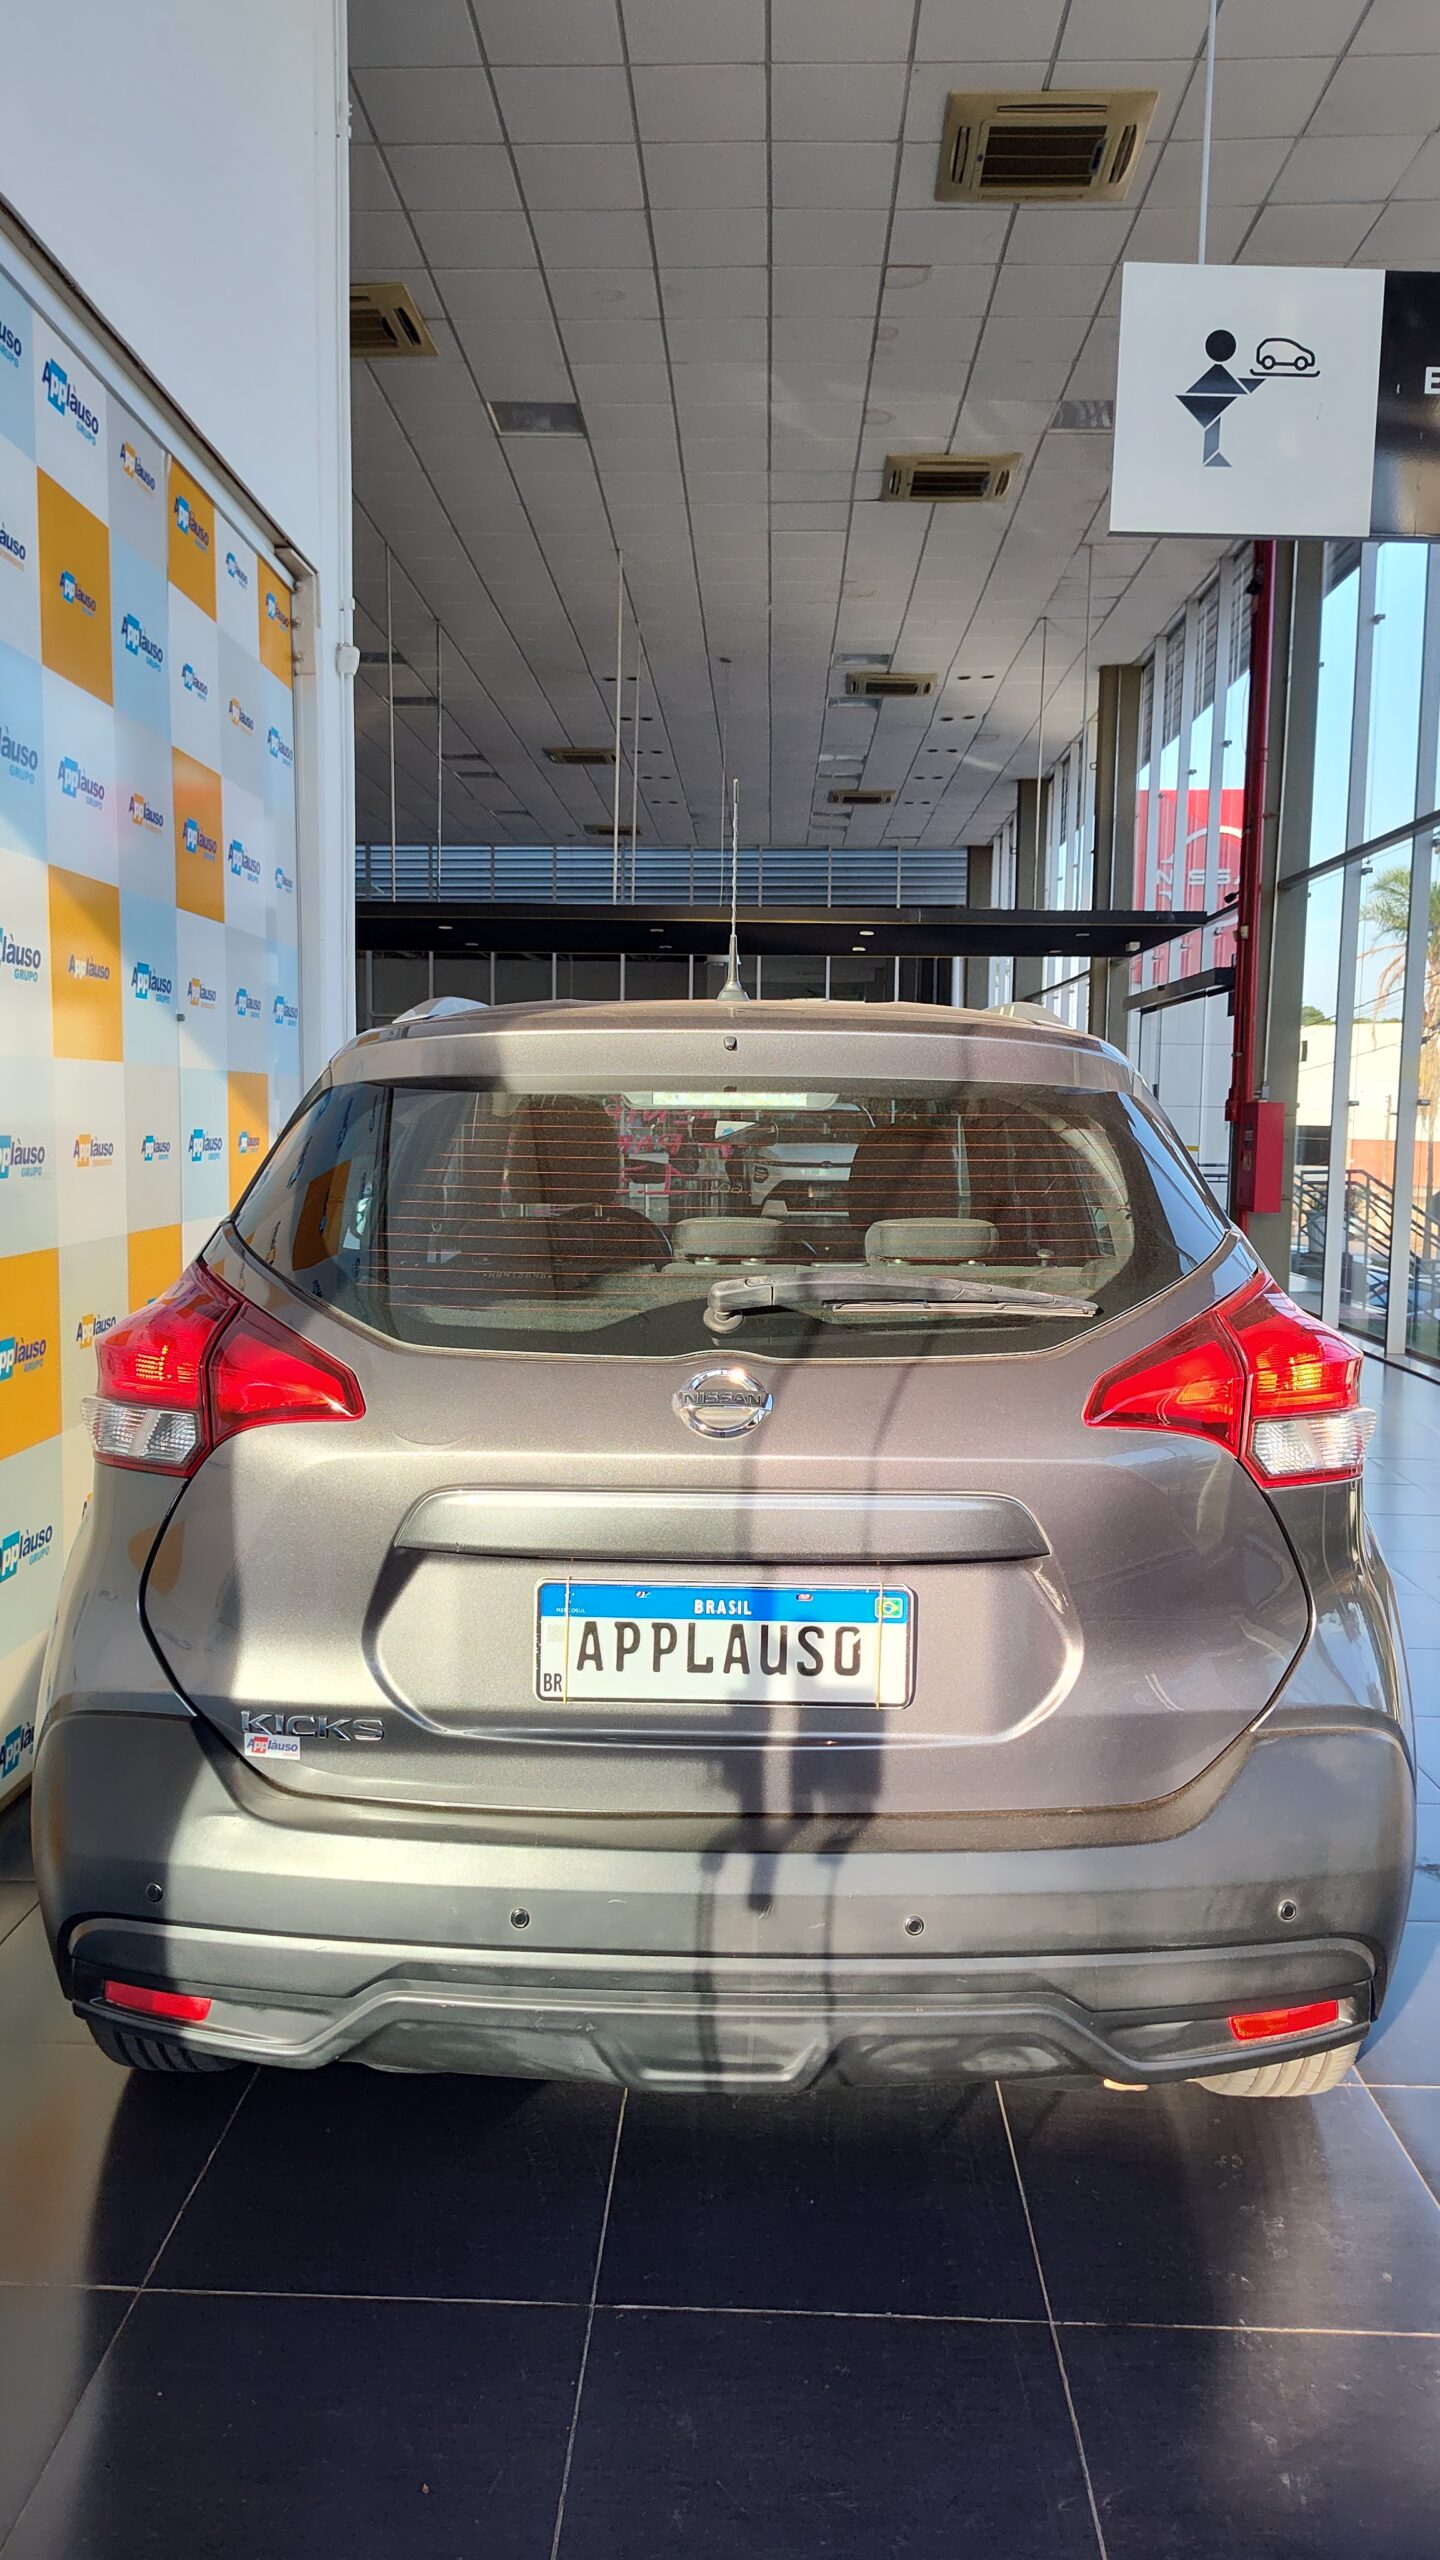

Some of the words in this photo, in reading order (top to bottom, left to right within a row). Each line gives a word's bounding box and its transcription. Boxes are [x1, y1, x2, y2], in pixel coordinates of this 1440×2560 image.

[14, 968, 38, 982] GRUPO
[684, 1391, 761, 1405] NISSAN
[694, 1599, 752, 1616] BRASIL
[576, 1621, 861, 1677] APPLAUSO
[543, 1673, 562, 1692] BR
[241, 1711, 384, 1742] KICKS
